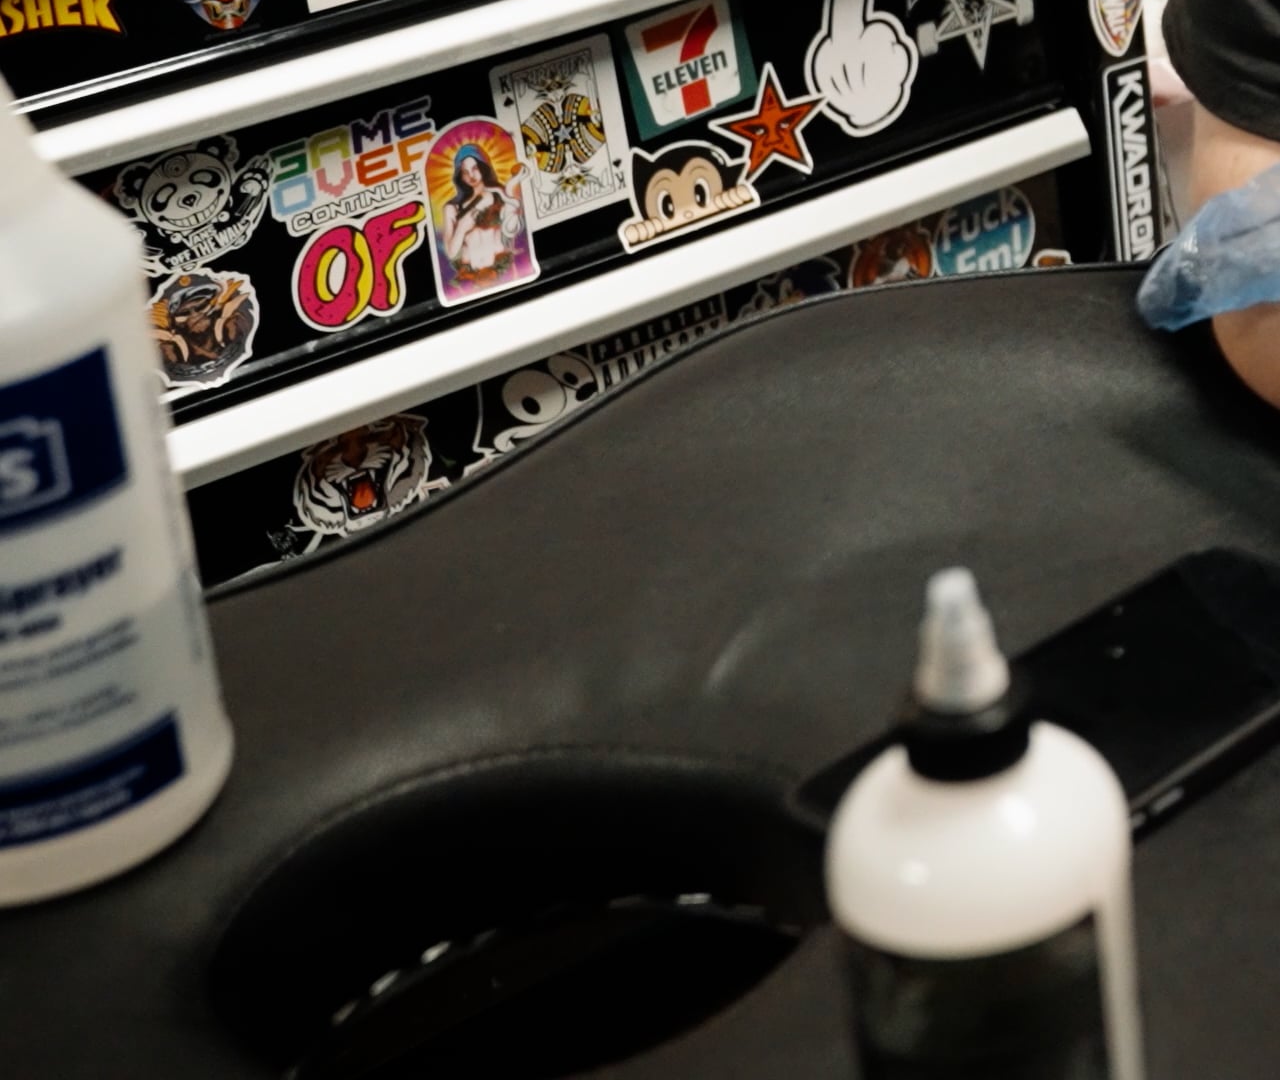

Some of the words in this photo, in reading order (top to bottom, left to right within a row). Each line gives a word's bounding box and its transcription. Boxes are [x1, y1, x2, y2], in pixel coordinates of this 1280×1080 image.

[498, 74, 512, 94] K
[1113, 70, 1156, 261] KWADRON
[292, 172, 421, 233] CONTINUE
[181, 224, 217, 247] VANS
[192, 235, 218, 257] THE
[298, 201, 427, 327] OF
[599, 300, 716, 360] PARENTAL
